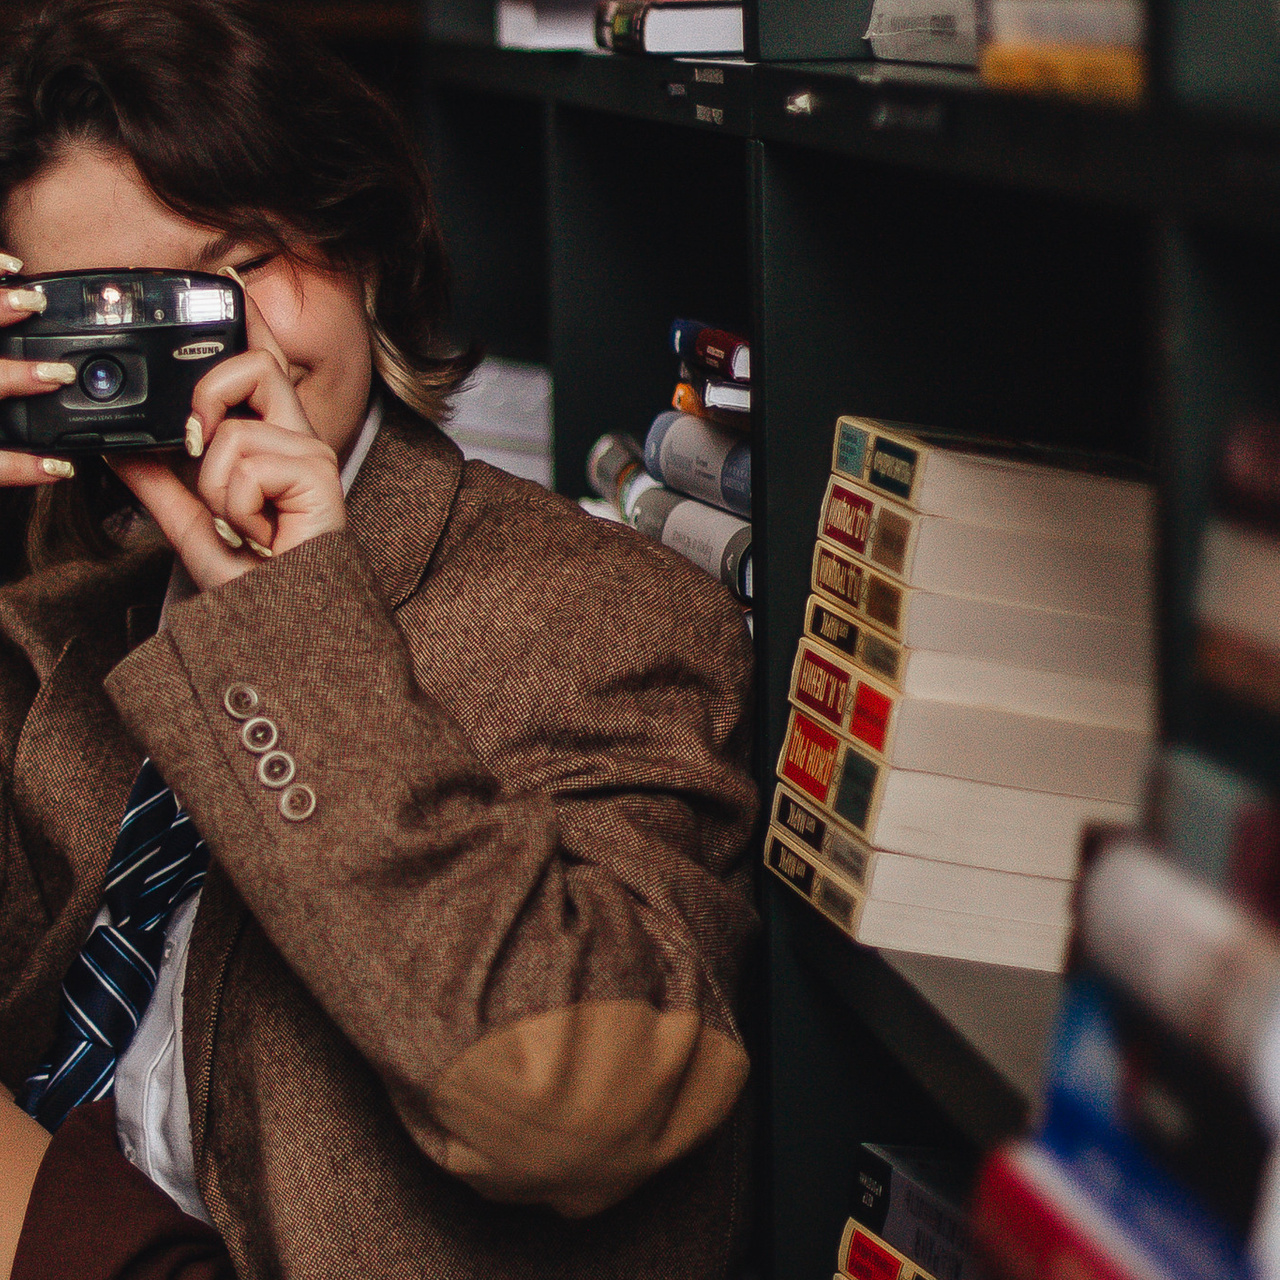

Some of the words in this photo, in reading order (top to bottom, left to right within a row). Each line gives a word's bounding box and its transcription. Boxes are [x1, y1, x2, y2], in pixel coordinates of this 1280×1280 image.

[177, 345, 220, 356] SAMSUNG
[799, 658, 829, 704] ЛЕНИН
[788, 723, 810, 769] РИД
[804, 737, 835, 786] ДЖОН
